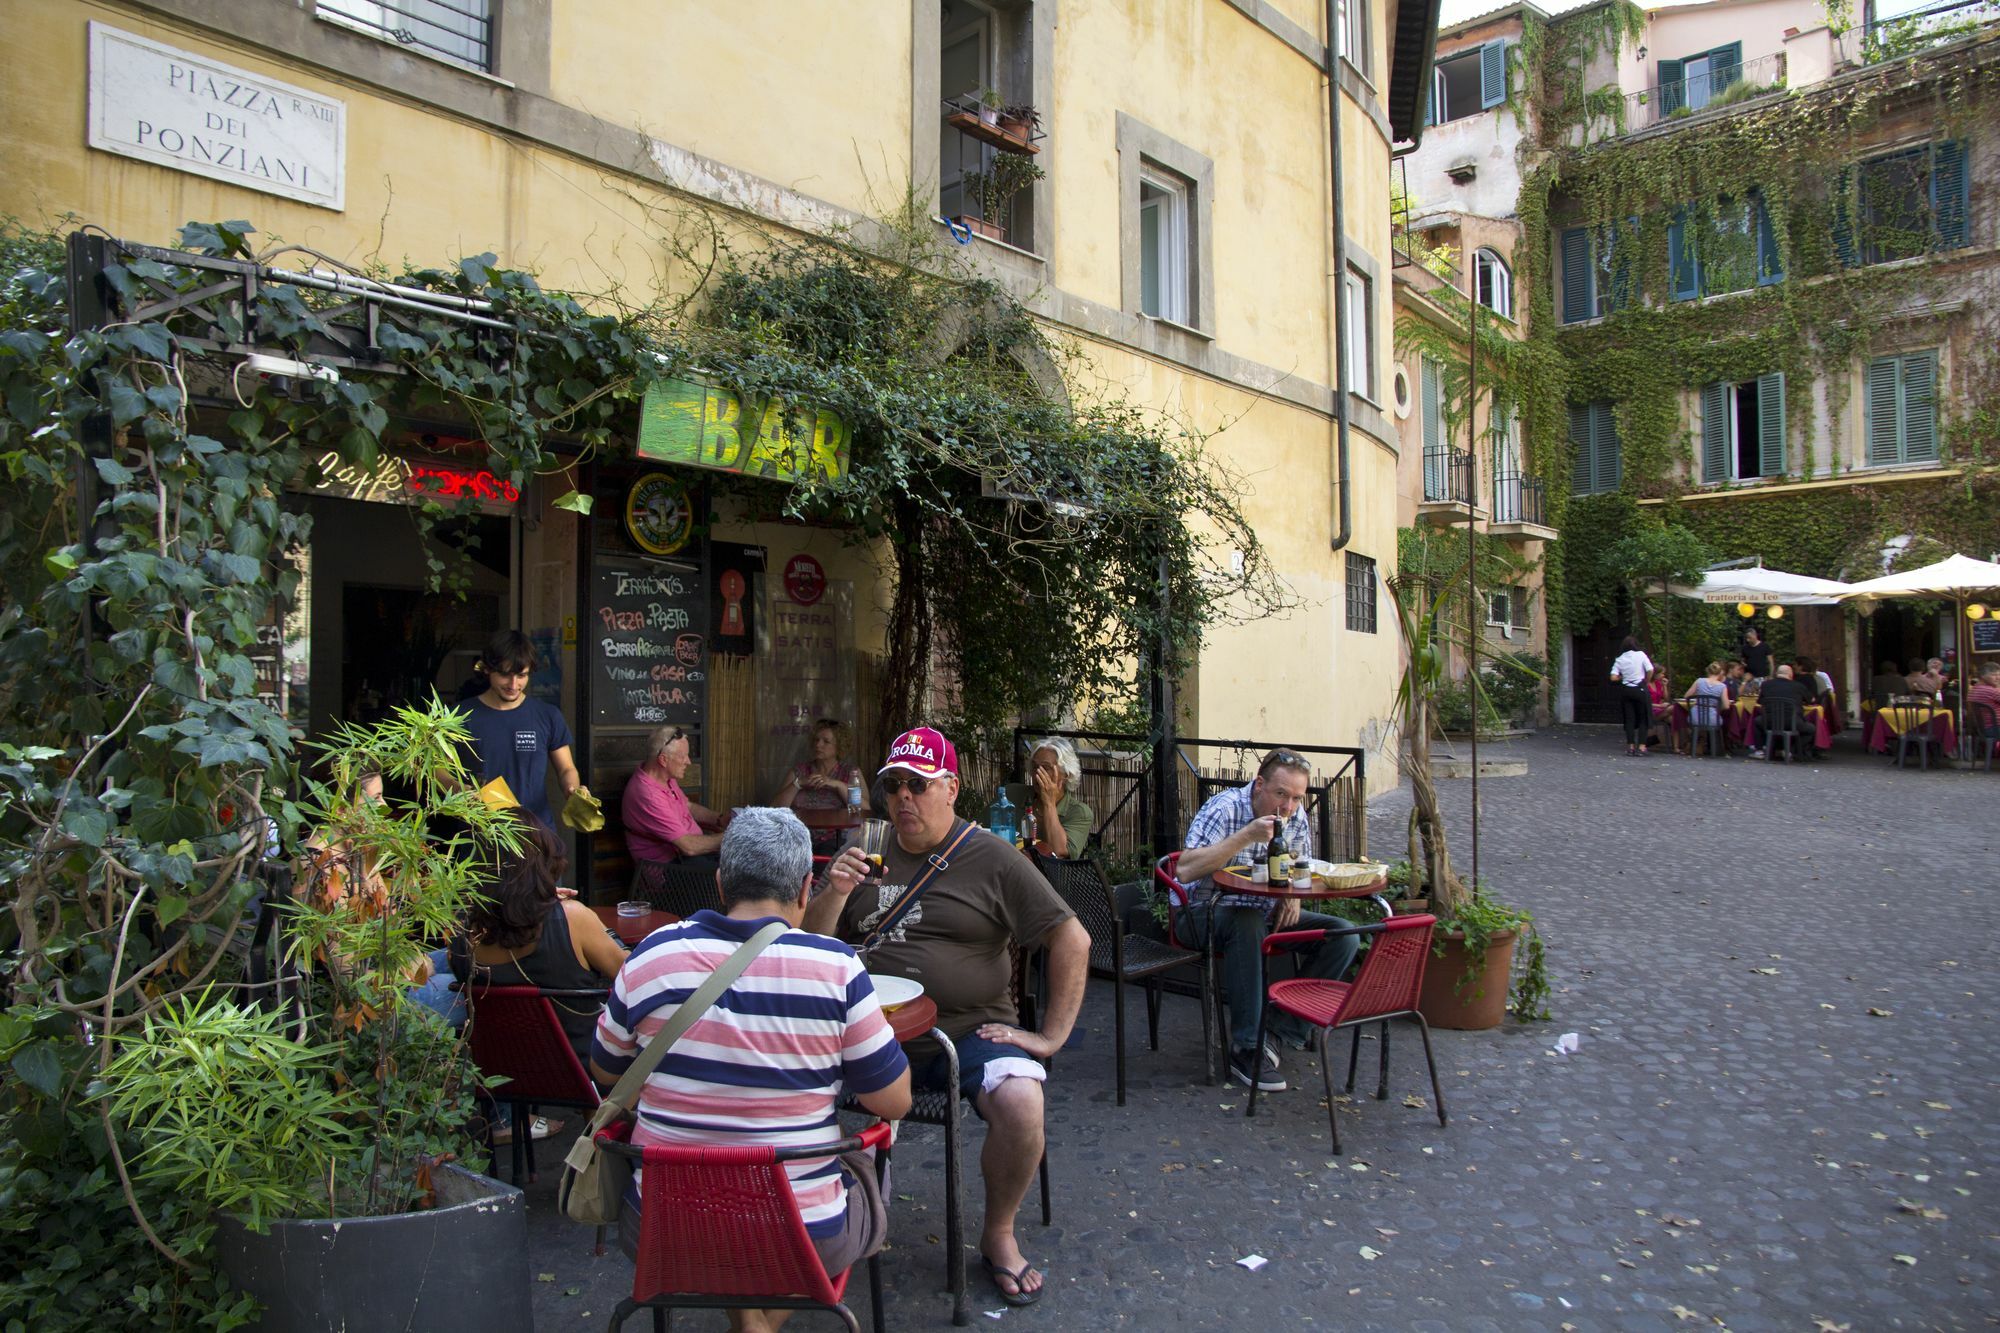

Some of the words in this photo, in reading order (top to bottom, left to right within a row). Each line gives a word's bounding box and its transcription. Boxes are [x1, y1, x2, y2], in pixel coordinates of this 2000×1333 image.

[168, 63, 283, 120] PIAZZA
[206, 112, 247, 138] DEI
[136, 120, 309, 187] PONZIANI
[701, 389, 845, 484] BAR
[1706, 593, 1747, 601] trattoria
[1762, 592, 1778, 601] Teo
[599, 606, 645, 632] PIZZA
[647, 602, 690, 631] PASTA
[776, 612, 834, 626] TERRA
[777, 635, 834, 649] SATIS
[605, 664, 636, 681] VINO
[650, 663, 686, 682] CASA
[891, 743, 935, 761] ROMA
